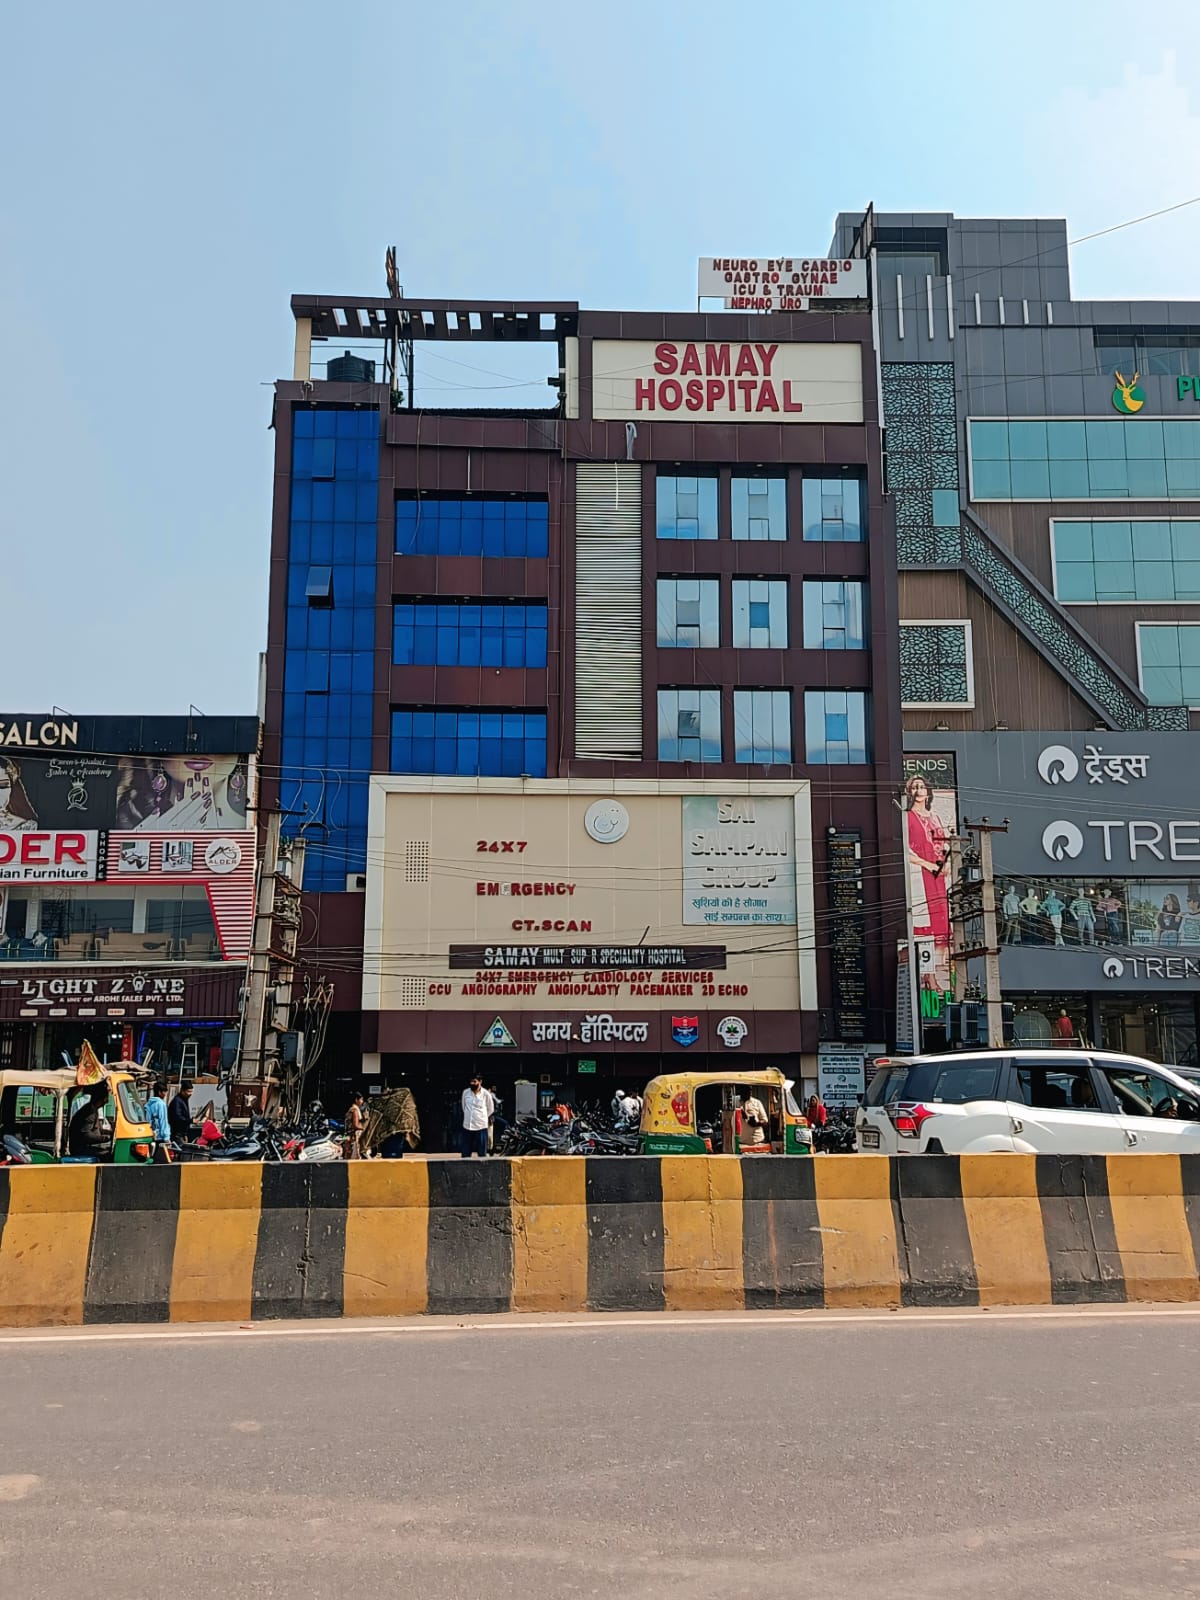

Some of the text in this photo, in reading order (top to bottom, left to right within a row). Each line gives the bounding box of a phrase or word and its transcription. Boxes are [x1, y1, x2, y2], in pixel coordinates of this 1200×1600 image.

[713, 259, 852, 272] NEURO EYE CARDIO
[724, 272, 838, 284] GASTRO GYNAE
[733, 284, 756, 295] ICU
[763, 284, 771, 296] &
[731, 296, 802, 309] NEPHRO URO
[653, 343, 779, 376] SAMAY
[635, 378, 803, 413] HOSPITAL
[1083, 745, 1150, 784] ट्रेंड्स
[719, 800, 756, 823] SAI
[476, 840, 528, 853] 24X7
[691, 831, 788, 856] SAMPAN
[1087, 820, 1200, 861] TRE
[24, 868, 88, 878] Furniture
[512, 920, 592, 932] CT.SCAN
[484, 947, 540, 966] SAMAY
[600, 948, 646, 964] SPECIALITY
[648, 949, 687, 964] HOSPITAL
[475, 971, 714, 983] 24X7 EMERGENCY CARDIOLOGY SERVICES
[21, 979, 97, 1003] LIGHT
[429, 983, 748, 996] CCU ANGIOGRAPHY ANGIOPLASTY PACEMAKER 2D ECHO
[532, 1014, 649, 1043] समय हॉस्पिटल
